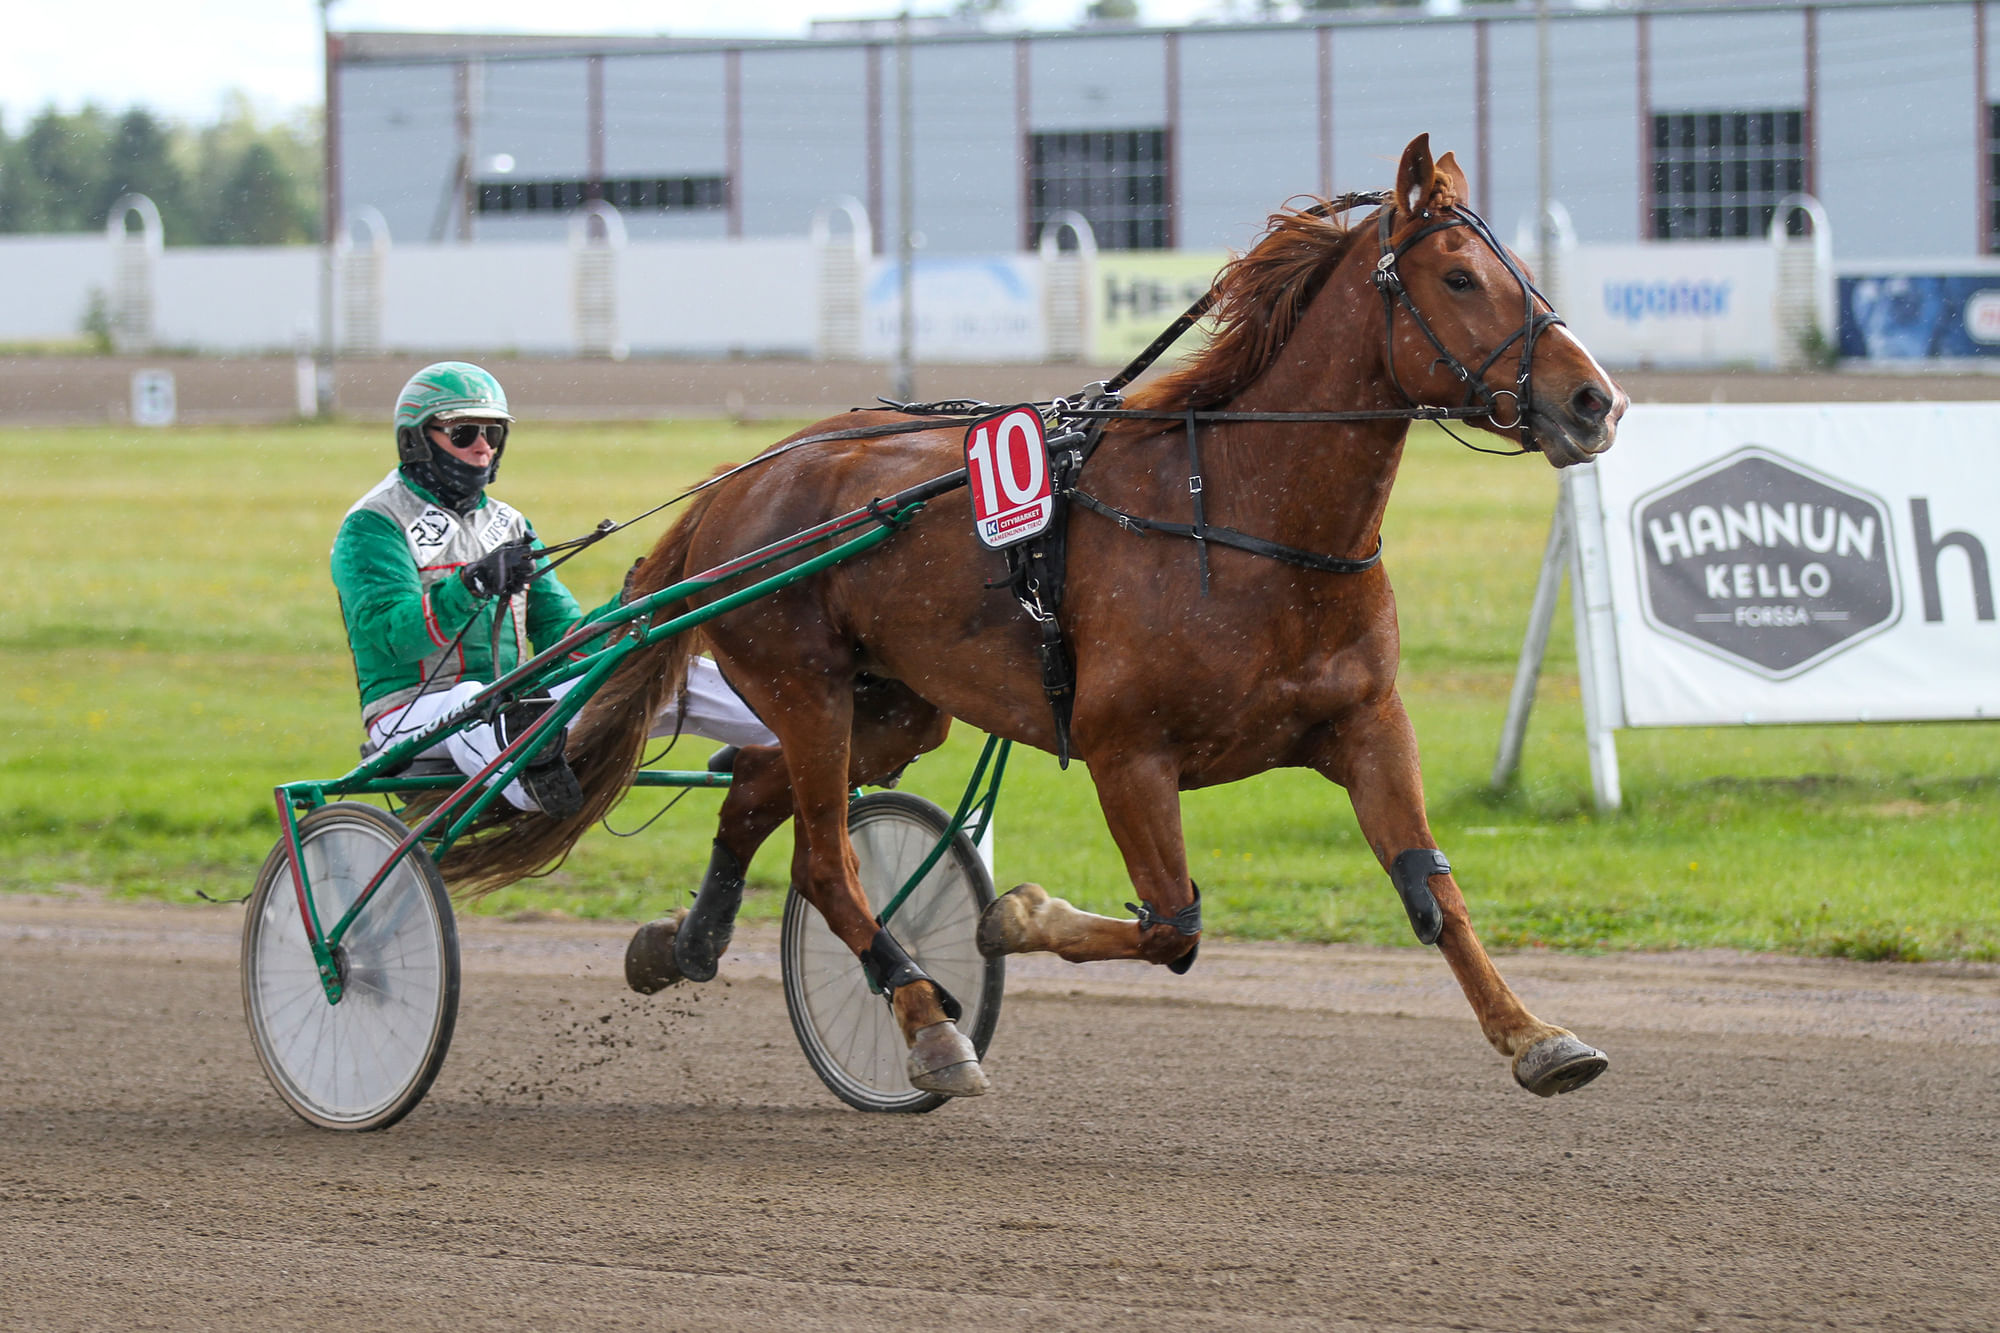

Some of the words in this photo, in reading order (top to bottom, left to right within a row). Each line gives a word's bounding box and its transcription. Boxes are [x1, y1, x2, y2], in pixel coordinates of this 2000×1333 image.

[969, 412, 1044, 516] 10
[1000, 509, 1040, 529] CITYMARKET
[1649, 501, 1875, 565] HANNUN
[1705, 562, 1831, 599] KELLO
[1734, 605, 1810, 627] FORSSA
